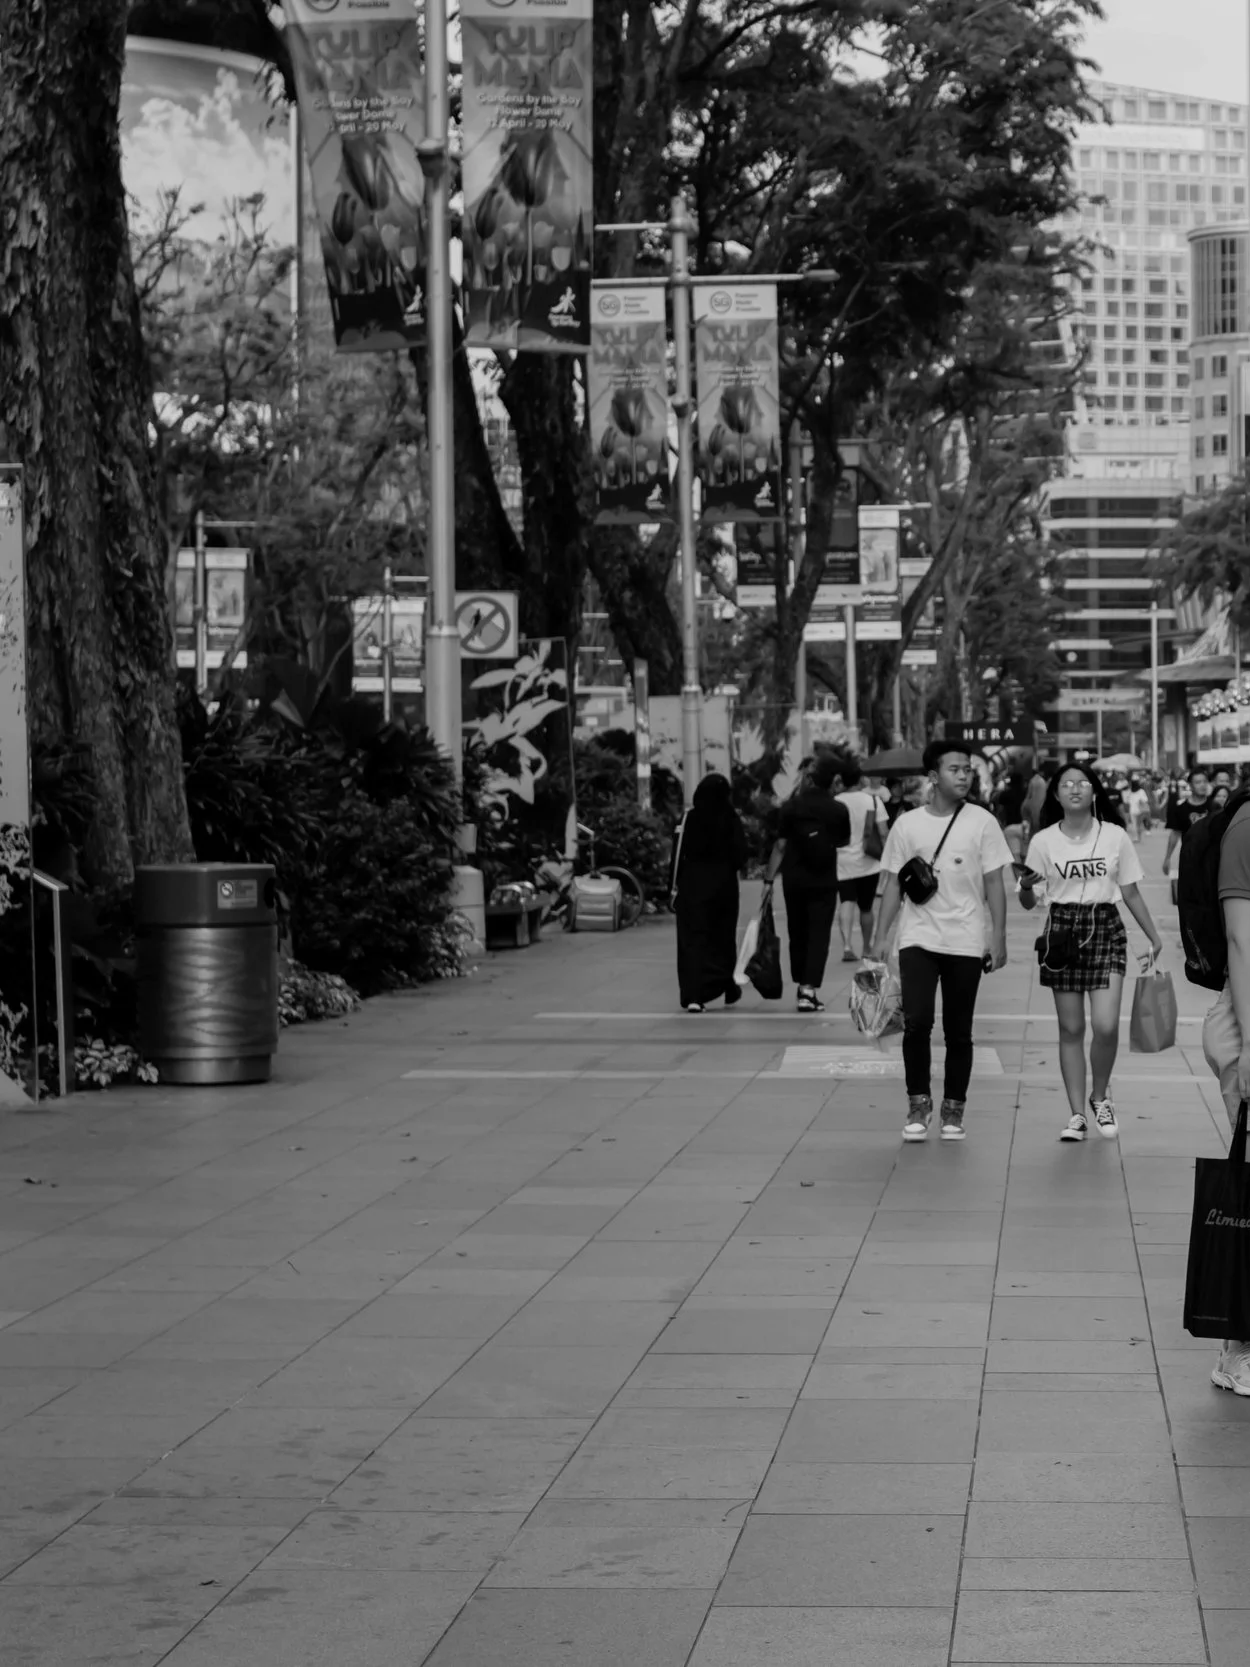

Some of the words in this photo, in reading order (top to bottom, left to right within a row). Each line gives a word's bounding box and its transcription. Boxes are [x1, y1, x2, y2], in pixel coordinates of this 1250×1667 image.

[480, 23, 577, 56] TULIP
[472, 56, 584, 92] MANIA
[526, 93, 541, 105] by
[541, 94, 558, 104] the
[962, 728, 1015, 741] HERA
[1054, 857, 1107, 880] VANS
